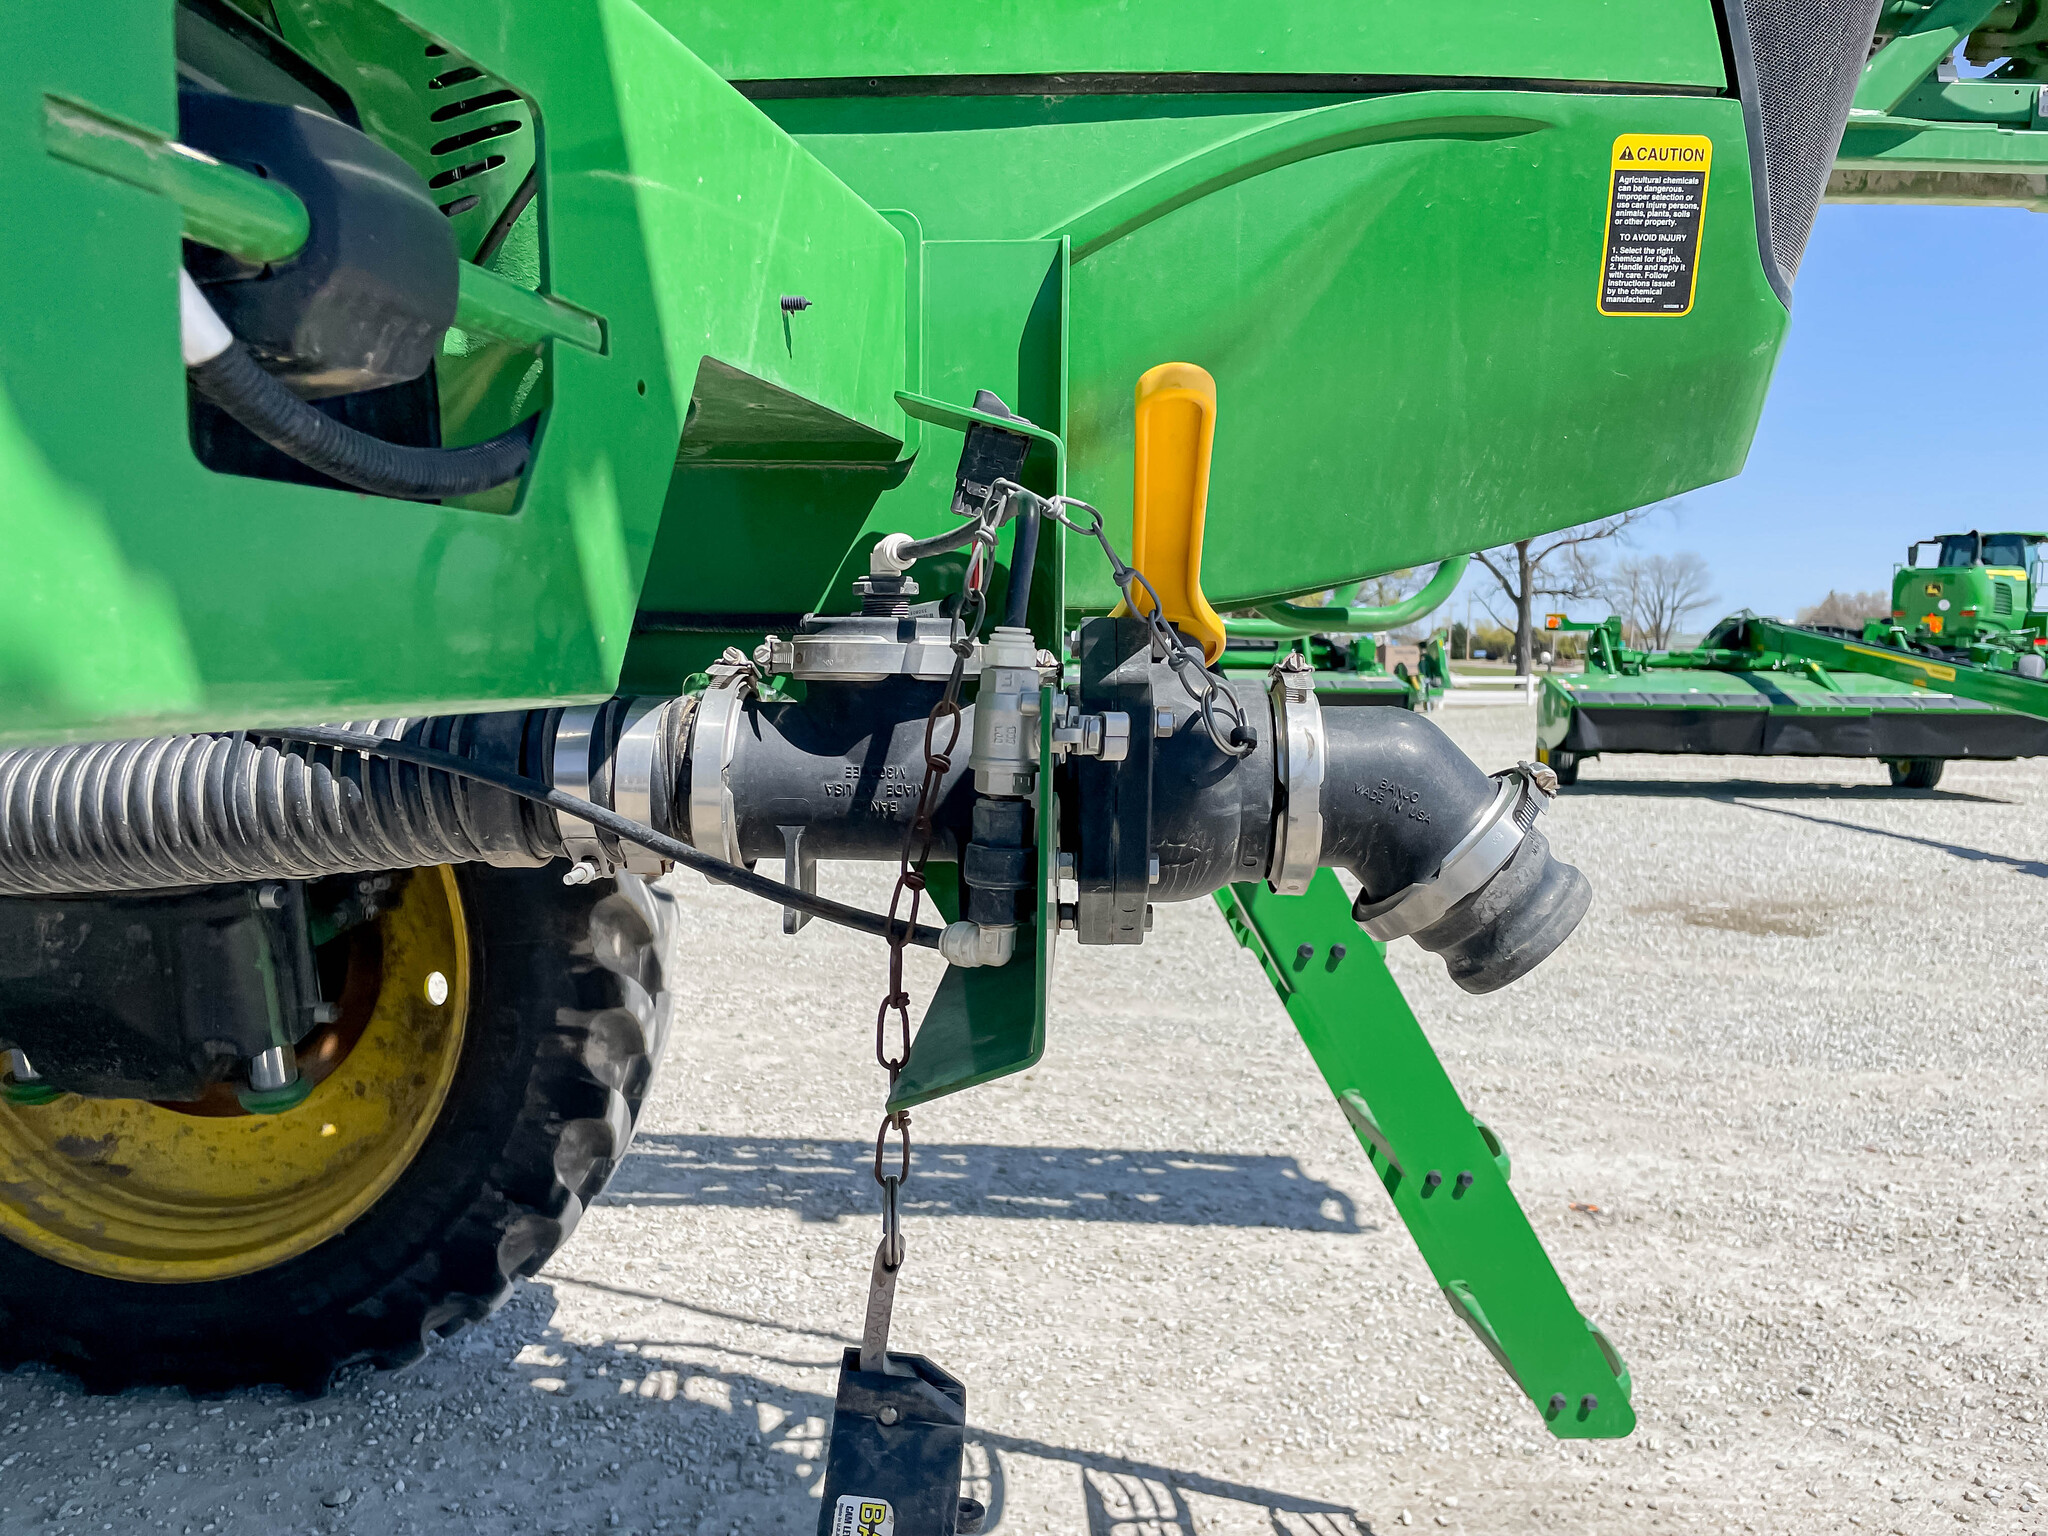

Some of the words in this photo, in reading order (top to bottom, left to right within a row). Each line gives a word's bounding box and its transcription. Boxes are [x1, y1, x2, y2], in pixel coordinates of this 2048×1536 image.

[1637, 147, 1705, 162] CAUTION
[1619, 175, 1661, 185] Agricultural
[1663, 176, 1699, 185] chemicals
[1644, 185, 1684, 194] dangerous.
[1617, 192, 1650, 201] Improper
[1646, 201, 1667, 210] injure
[1668, 203, 1699, 211] persons,
[1616, 210, 1645, 218] animals,
[1647, 210, 1671, 218] plants,
[1673, 210, 1690, 218] soils
[1645, 219, 1677, 228] property.
[1620, 233, 1630, 241] TO
[1632, 233, 1657, 241] AVOID
[1658, 234, 1687, 242] INJURY
[1657, 247, 1673, 256] right
[1644, 255, 1654, 263] for
[1669, 256, 1682, 264] job.
[1659, 264, 1679, 273] apply
[1609, 271, 1623, 279] with
[1645, 271, 1668, 279] Follow
[1608, 279, 1650, 287] instructions
[1607, 287, 1616, 296] by
[824, 783, 854, 798] USA
[1379, 777, 1420, 803] BANJO
[1353, 782, 1385, 805] MADE
[1408, 806, 1431, 826] USA
[844, 1505, 854, 1524] CAM
